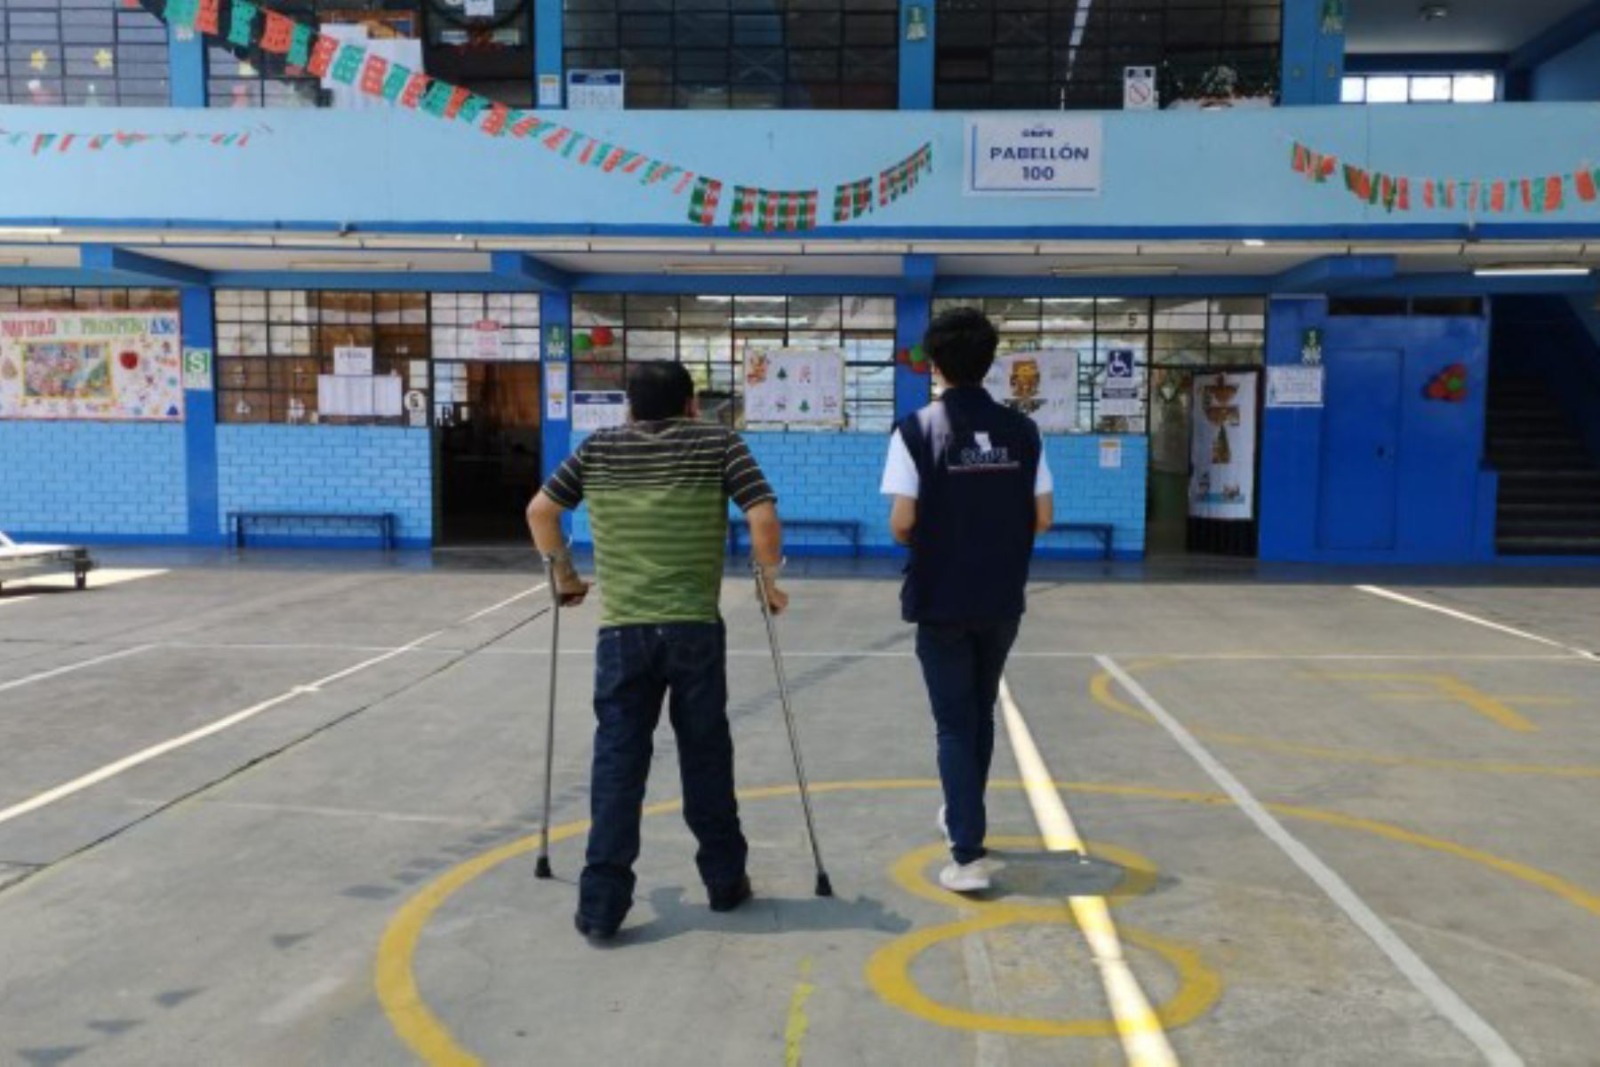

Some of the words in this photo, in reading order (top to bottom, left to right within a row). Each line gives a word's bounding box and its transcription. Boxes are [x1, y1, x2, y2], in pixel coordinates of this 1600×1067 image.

[990, 142, 1089, 160] PABELLÓN
[1022, 166, 1054, 180] 100
[190, 352, 205, 373] S
